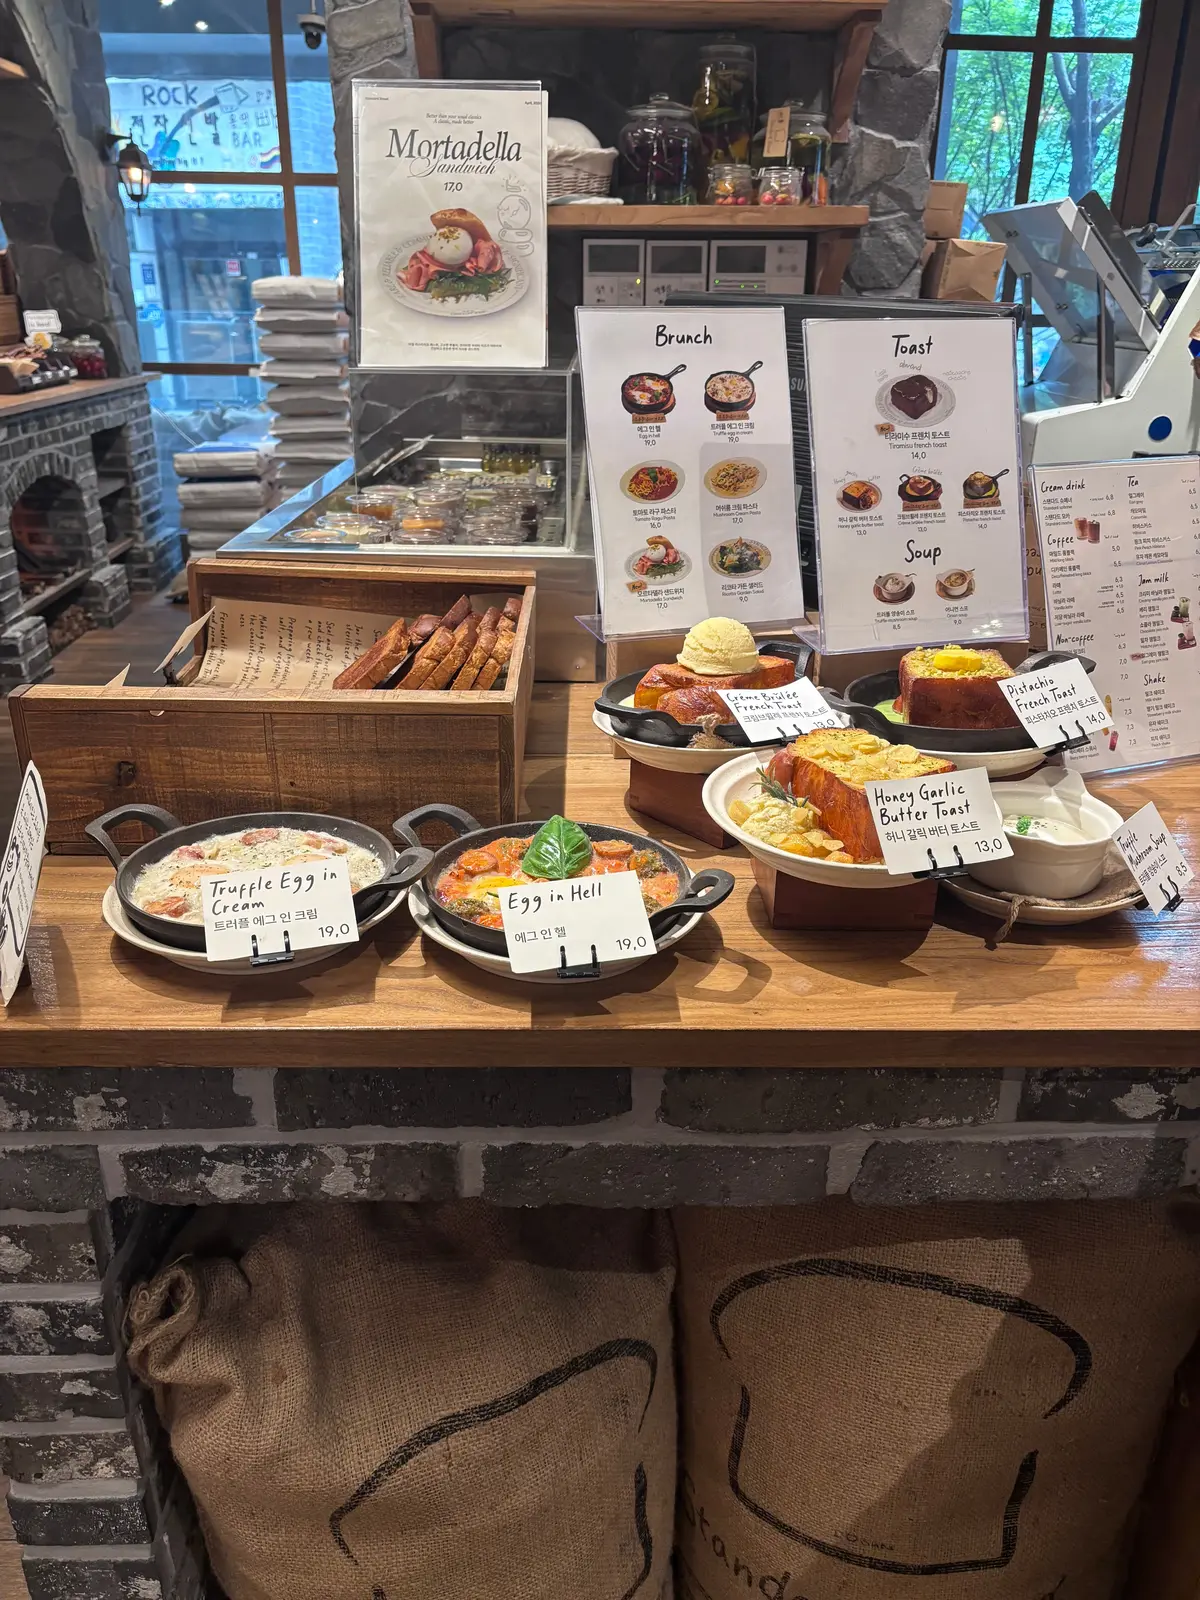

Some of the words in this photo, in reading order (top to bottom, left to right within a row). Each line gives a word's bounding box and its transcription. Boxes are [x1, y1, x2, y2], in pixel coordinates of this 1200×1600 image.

[142, 84, 199, 106] ROCK
[232, 132, 262, 148] BAR
[386, 128, 522, 162] Mortadella
[407, 155, 500, 178] Sandwich
[444, 182, 463, 192] 17,0
[655, 324, 713, 347] Brunch
[892, 335, 934, 357] Toast
[655, 425, 661, 433] 헬
[744, 422, 755, 430] 크림
[644, 439, 657, 447] 19,0
[728, 436, 740, 444] 19,0
[885, 432, 910, 441] 티라미수
[911, 432, 930, 440] 프렌치
[931, 431, 950, 439] 토스트
[889, 442, 913, 450] Tiramisu
[911, 452, 927, 460] 14,0
[1041, 482, 1064, 493] Cream
[1066, 479, 1086, 491] drink
[1127, 476, 1139, 488] Tea
[632, 509, 648, 517] 토마토
[661, 507, 676, 515] 파스타
[650, 522, 662, 530] 16,0
[1047, 534, 1074, 548] Coffee
[905, 540, 942, 565] Soup
[737, 582, 747, 590] 가든
[1115, 576, 1124, 584] 6,3
[1138, 574, 1152, 587] Jam
[1154, 572, 1169, 584] milk
[249, 614, 258, 626] the
[255, 614, 268, 640] Making
[278, 617, 287, 633] salt,
[317, 621, 325, 634] and
[285, 617, 297, 652] Preparing
[304, 626, 313, 640] few
[325, 621, 335, 636] Seal
[244, 628, 257, 666] consistency
[316, 636, 324, 656] check
[326, 638, 334, 651] and
[344, 624, 353, 660] sterilized
[354, 639, 362, 651] the
[1056, 634, 1095, 647] Non-coffee
[258, 643, 266, 654] the
[313, 658, 322, 669] the
[1143, 672, 1166, 686] Shake
[1006, 676, 1054, 699] Pistachio
[1015, 693, 1050, 714] French
[1049, 684, 1077, 703] Toast
[734, 702, 773, 714] French
[773, 701, 803, 711] Toast
[782, 711, 803, 720] 프렌치
[804, 706, 829, 718] 토스트
[1024, 709, 1058, 725] 피스타치오
[1057, 702, 1079, 716] 프렌치
[1077, 696, 1099, 709] 토스트
[1124, 708, 1132, 716] 7,3
[813, 719, 836, 729] 13,0
[1086, 711, 1106, 725] 14,0
[1127, 723, 1135, 731] 7,3
[1129, 738, 1137, 746] 7,3
[874, 788, 914, 807] Honey
[919, 782, 966, 801] Garlic
[880, 808, 928, 826] Butter
[932, 799, 971, 820] Toast
[885, 830, 906, 843] 허니
[907, 827, 928, 840] 갈릭
[929, 826, 950, 838] 버터
[951, 820, 982, 835] 토스트
[975, 838, 1003, 853] 13,0
[1117, 829, 1139, 855] Truffle
[1127, 845, 1153, 872] Mushroom
[1150, 832, 1168, 851] Soup
[1176, 861, 1188, 877] 8,5
[210, 876, 273, 900] Truffle
[280, 872, 315, 894] Egg
[323, 868, 337, 881] in
[508, 892, 542, 915] Egg
[550, 889, 564, 902] in
[571, 883, 602, 902] Hell
[212, 899, 265, 916] Cream
[213, 917, 250, 932] 트러플
[253, 914, 277, 927] 에그
[280, 912, 292, 923] 인
[295, 908, 318, 920] 크림
[318, 923, 350, 938] 19,0
[515, 929, 539, 944] 에그
[540, 928, 552, 940] 인
[554, 926, 567, 938] 헬
[616, 936, 647, 951] 19,0
